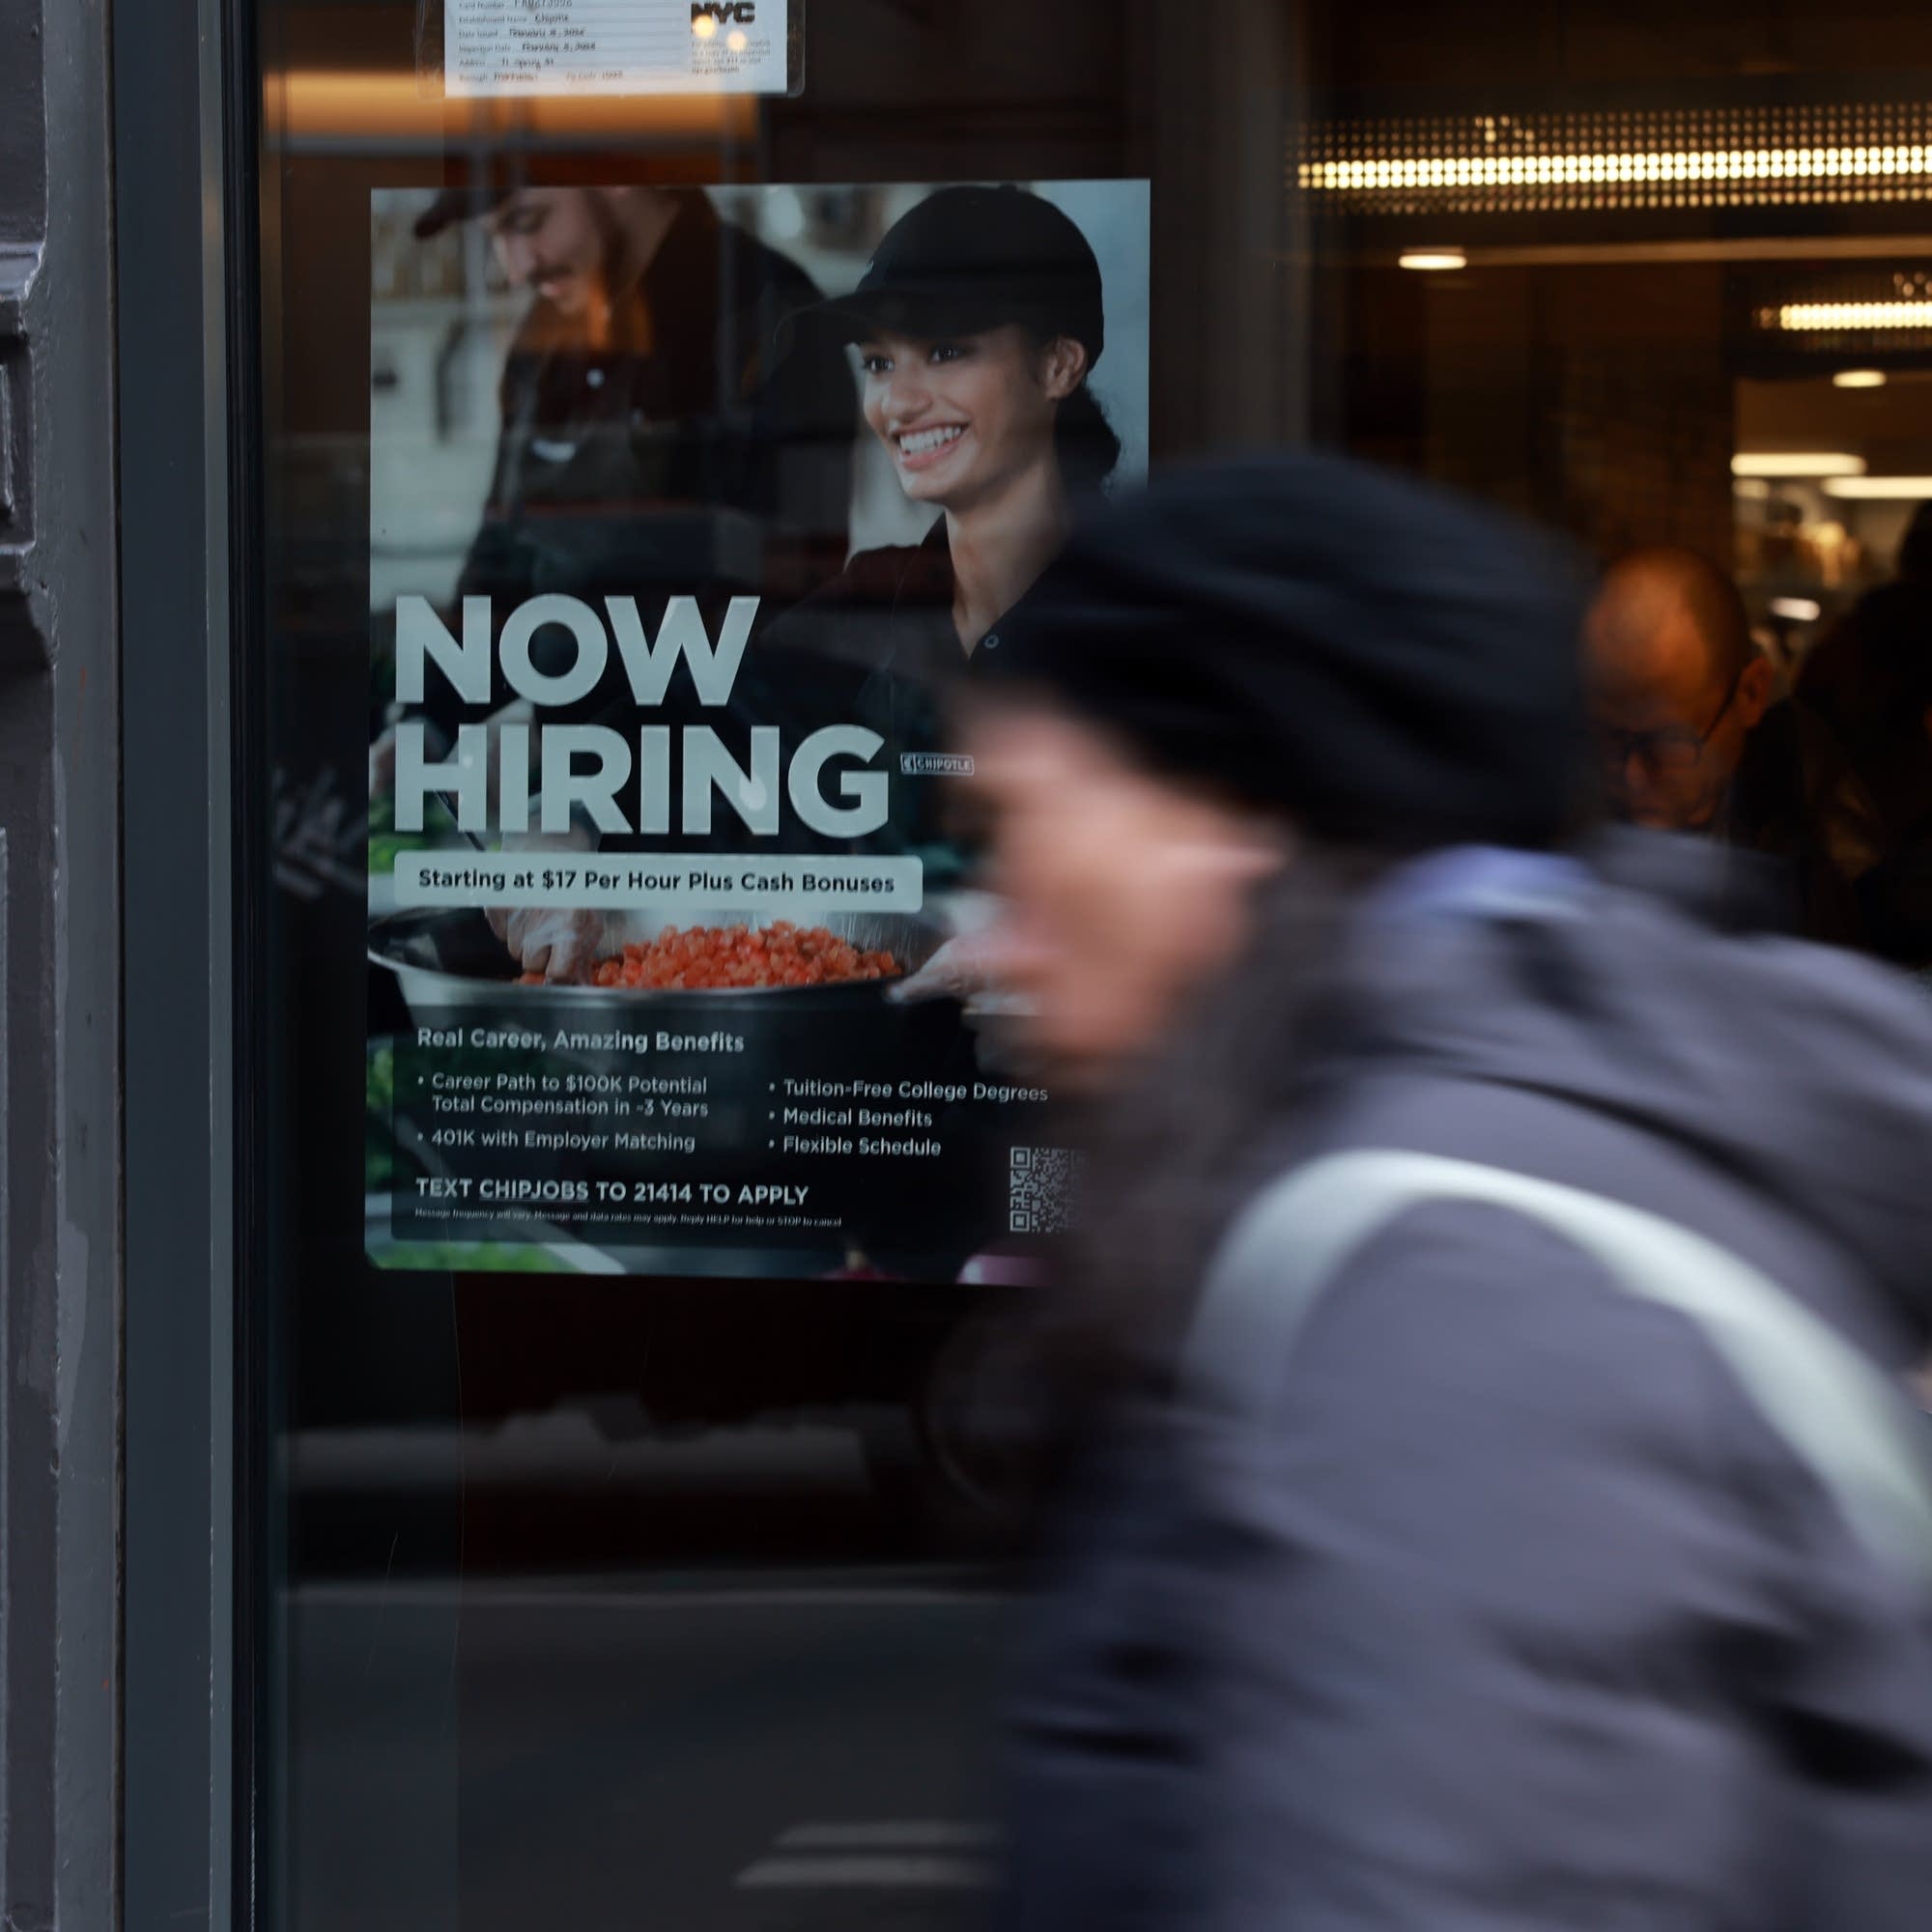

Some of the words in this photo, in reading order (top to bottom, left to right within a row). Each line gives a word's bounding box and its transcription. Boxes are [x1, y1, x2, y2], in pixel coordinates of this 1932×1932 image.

[691, 2, 755, 24] NYC
[395, 593, 761, 706] NOW
[917, 756, 971, 772] CHIPOTLE
[394, 724, 890, 838] HIRING
[418, 868, 506, 891] Starting
[513, 871, 534, 889] at
[542, 868, 578, 890] $17
[584, 871, 620, 889] Per
[628, 871, 681, 891] Hour
[689, 872, 733, 891] Plus
[741, 872, 794, 892] Cash
[802, 873, 895, 894] Bonuses
[416, 1028, 464, 1048] Real
[469, 1029, 547, 1052] Career,
[553, 1030, 648, 1054] Amazing
[655, 1031, 745, 1054] Benefits
[432, 1073, 491, 1091] Career
[497, 1073, 536, 1092] Path
[541, 1076, 560, 1092] to
[565, 1073, 623, 1094] $100K
[628, 1076, 708, 1094] Potential
[783, 1078, 893, 1098] Tuition-Free
[898, 1081, 967, 1103] College
[973, 1083, 1049, 1103] Degrees
[432, 1094, 475, 1112] Total
[481, 1095, 611, 1117] Compensation
[614, 1096, 630, 1116] in
[661, 1099, 709, 1118] Years
[783, 1108, 853, 1126] Medical
[858, 1109, 933, 1128] Benefits
[432, 1129, 475, 1147] 401K
[480, 1129, 520, 1148] with
[525, 1130, 610, 1152] Employer
[614, 1132, 696, 1153] Matching
[783, 1135, 853, 1155] Flexible
[859, 1137, 942, 1157] Schedule
[416, 1178, 473, 1198] TEXT
[479, 1179, 589, 1202] CHIPJOBS
[595, 1181, 626, 1202] TO
[634, 1182, 694, 1203] 21414
[699, 1184, 730, 1204] TO
[737, 1185, 810, 1207] APPLY
